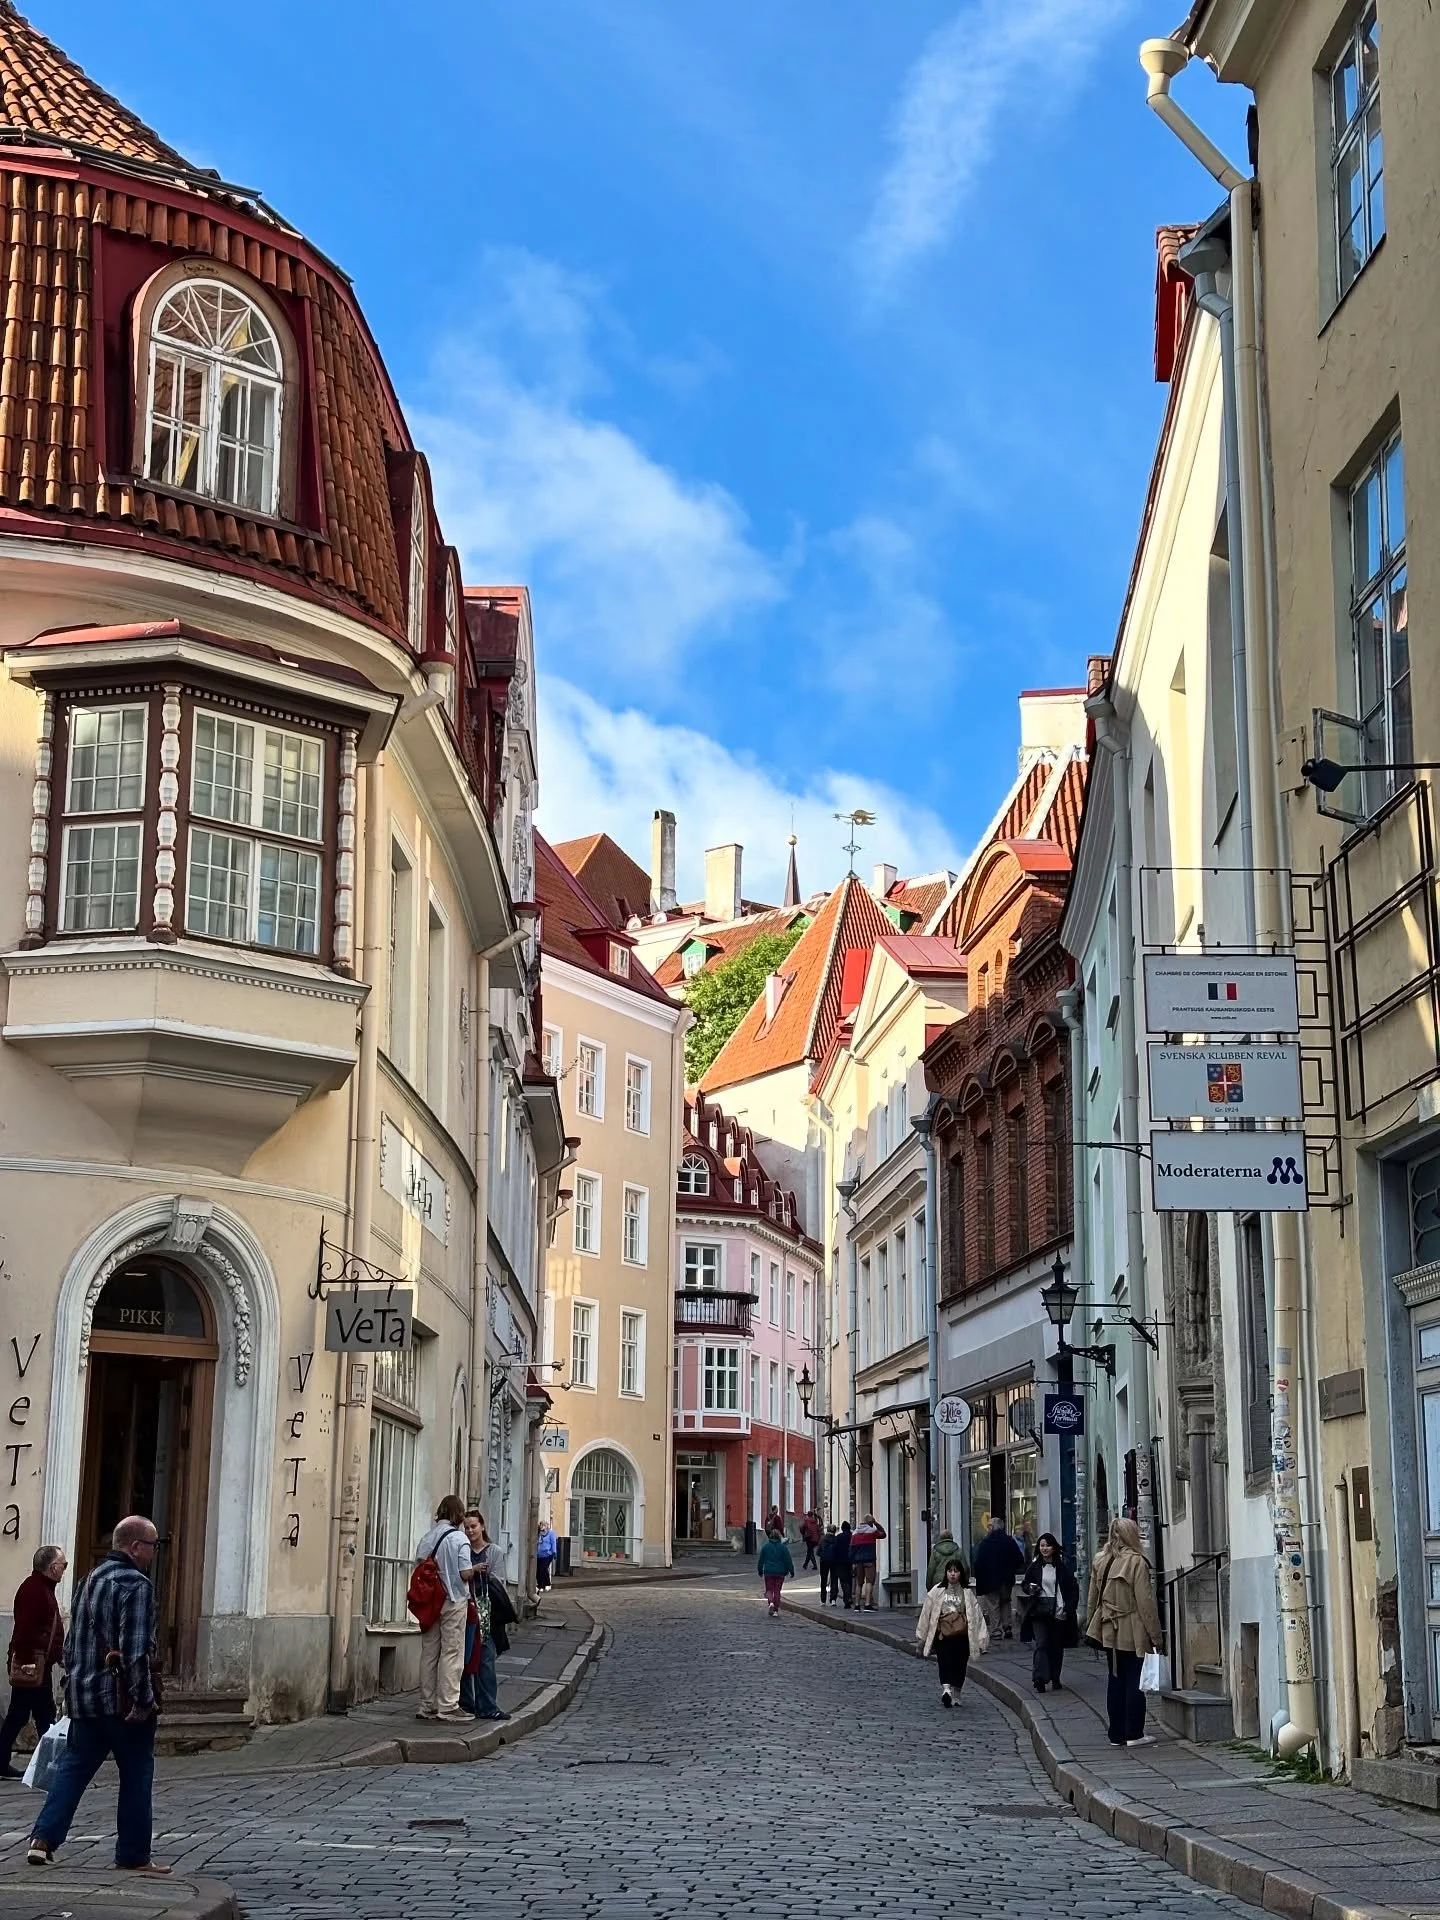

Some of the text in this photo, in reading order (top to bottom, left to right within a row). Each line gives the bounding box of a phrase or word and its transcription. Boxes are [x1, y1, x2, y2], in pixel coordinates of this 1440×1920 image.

[1160, 1052, 1287, 1060] SVENSKA KLUBBEN REVAL
[1156, 1163, 1262, 1178] Moderaterna
[119, 1308, 162, 1325] PIKK
[335, 1308, 405, 1347] VeTa
